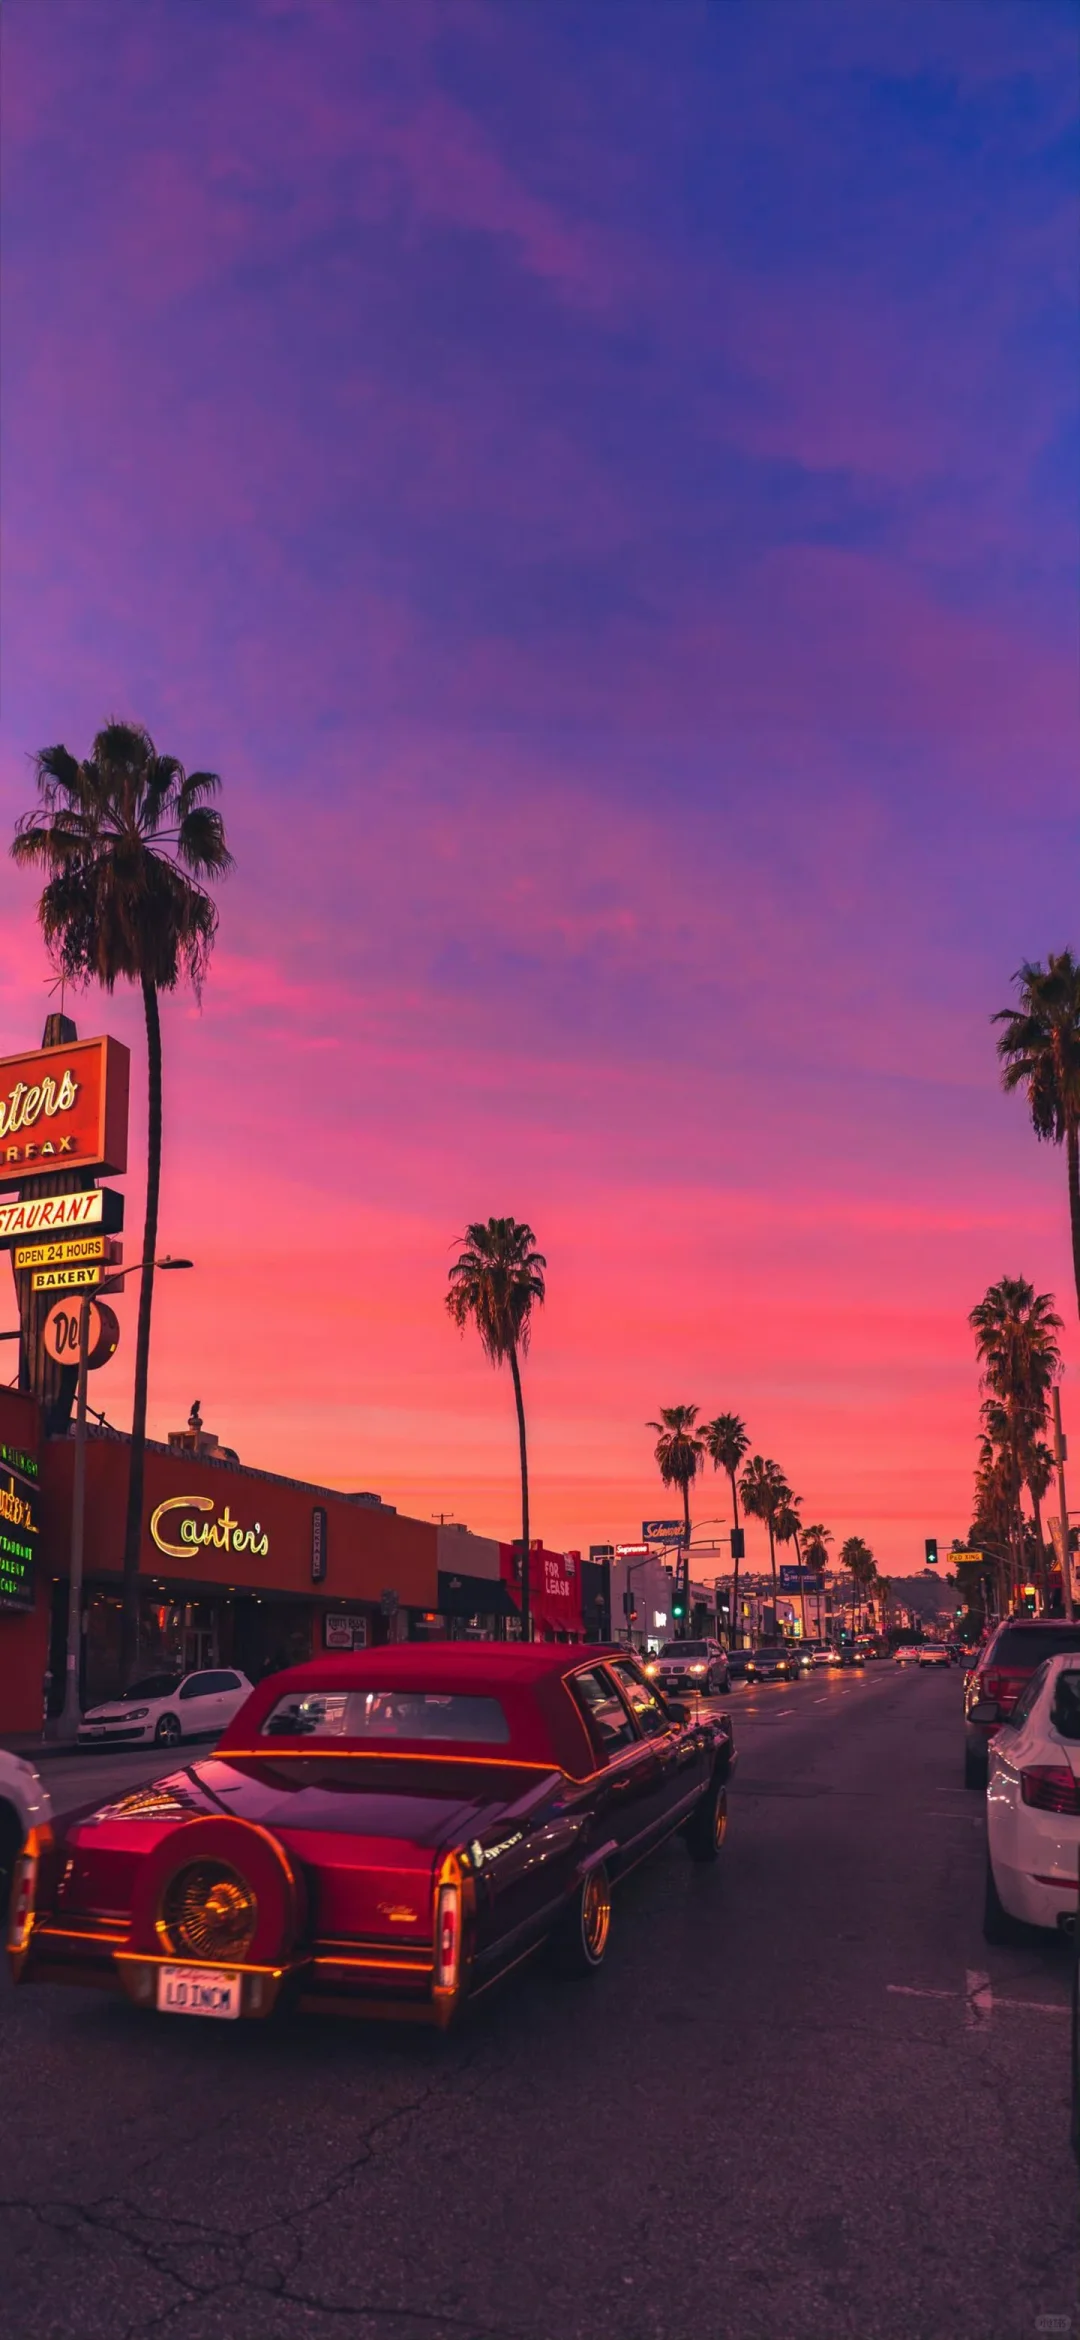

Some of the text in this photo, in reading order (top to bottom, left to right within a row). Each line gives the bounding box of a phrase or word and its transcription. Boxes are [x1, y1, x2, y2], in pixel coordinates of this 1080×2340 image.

[18, 1241, 101, 1264] OPEN 24 HOURS
[36, 1269, 96, 1287] BAKERY
[150, 1495, 269, 1558] Canter's
[544, 1560, 560, 1578] FOR
[545, 1577, 570, 1597] LEASE
